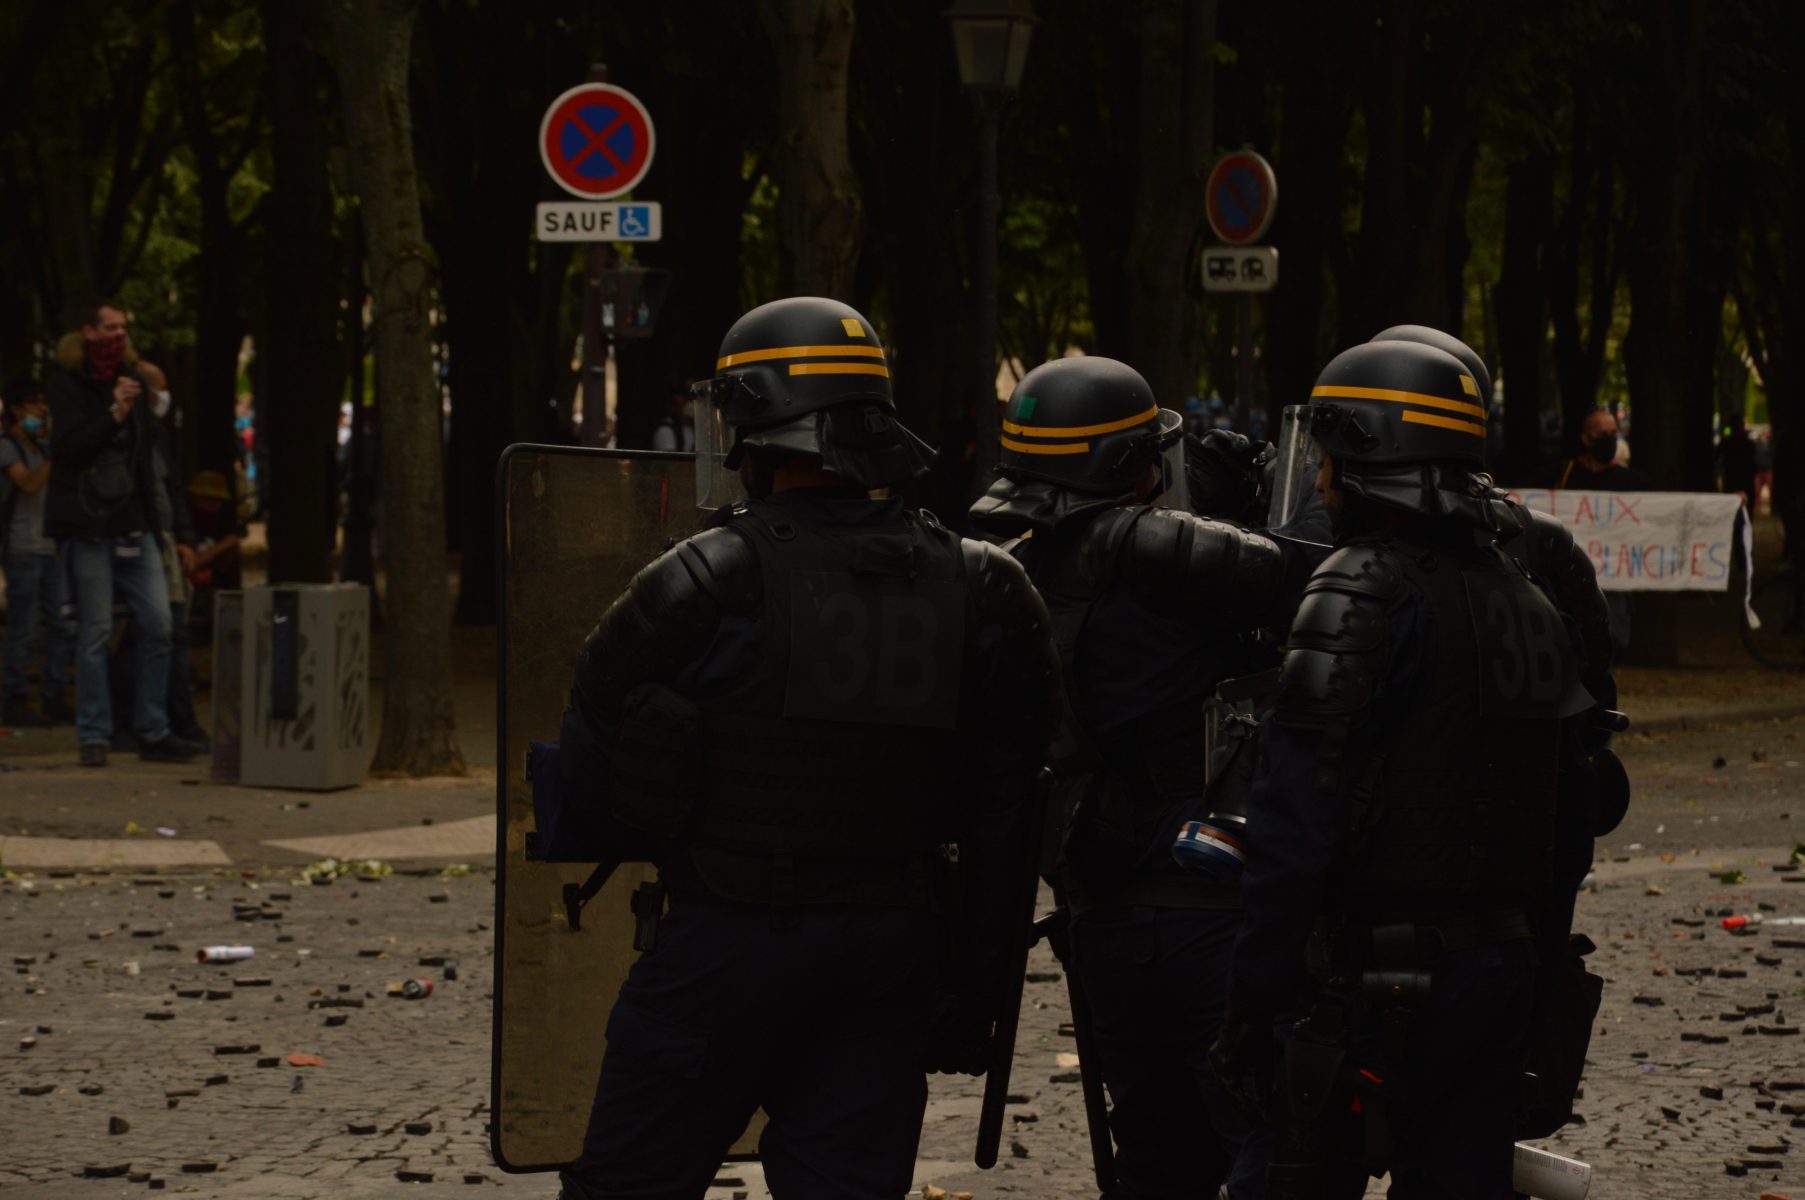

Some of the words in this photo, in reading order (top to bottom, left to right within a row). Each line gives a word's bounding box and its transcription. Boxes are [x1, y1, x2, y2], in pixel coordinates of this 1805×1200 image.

[544, 212, 613, 232] SAUF
[1574, 494, 1642, 528] AUX
[814, 592, 939, 708] 3B
[1487, 589, 1563, 701] 3B
